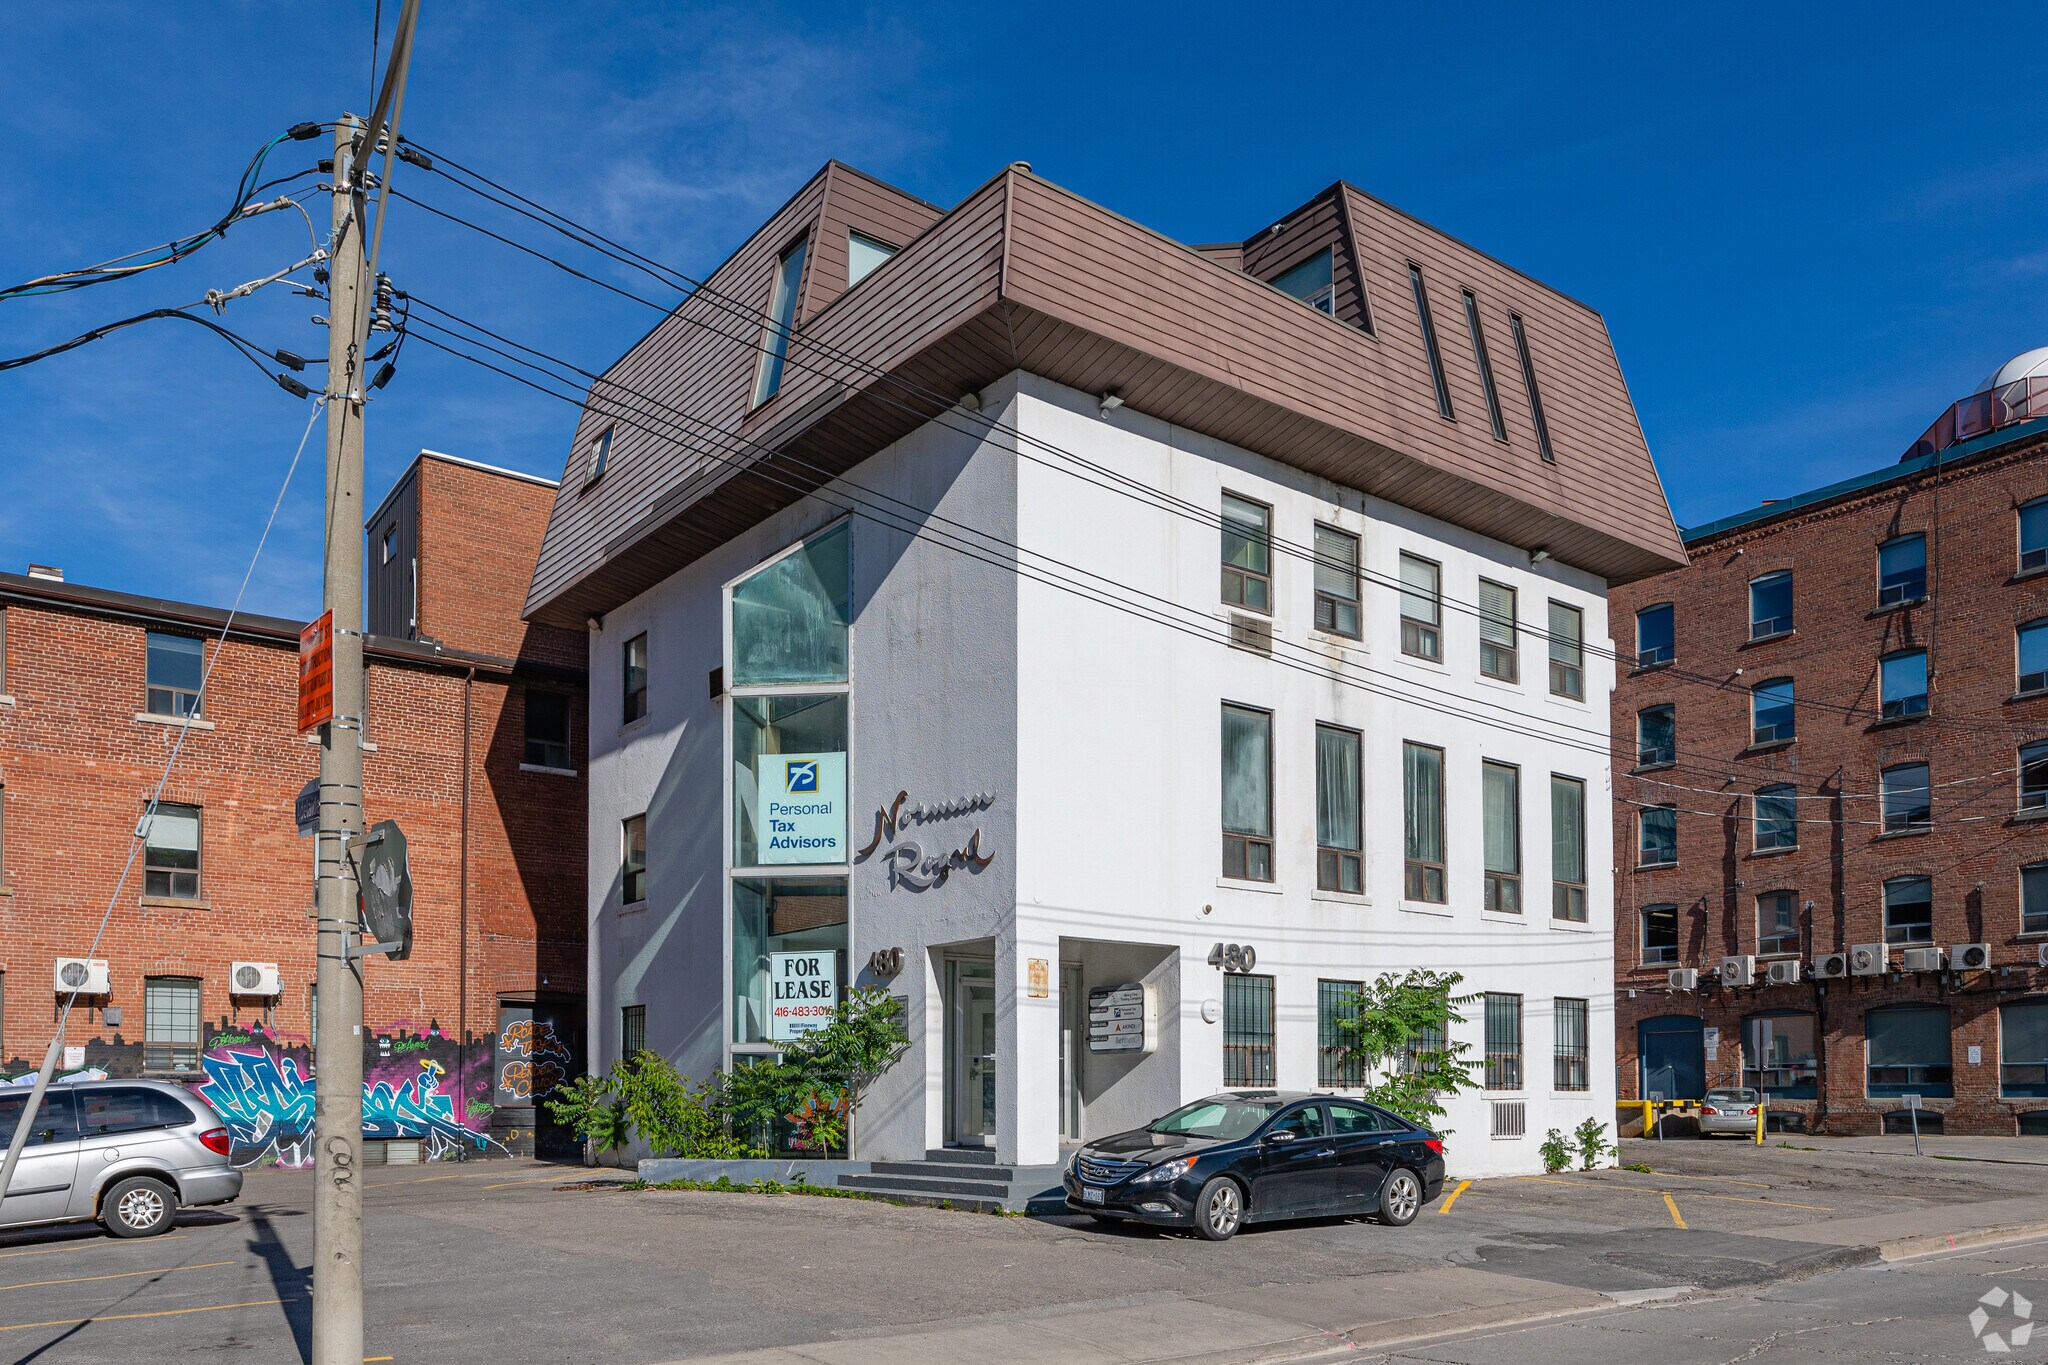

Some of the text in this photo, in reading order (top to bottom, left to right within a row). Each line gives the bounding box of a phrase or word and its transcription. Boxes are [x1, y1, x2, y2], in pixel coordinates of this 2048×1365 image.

[770, 801, 832, 815] Personal
[769, 820, 795, 832] Tax
[857, 790, 998, 857] Norman
[769, 836, 836, 849] Advisors
[868, 946, 905, 976] 480
[1207, 942, 1256, 973] 480
[784, 958, 820, 977] FOR
[774, 980, 833, 1000] LEASE
